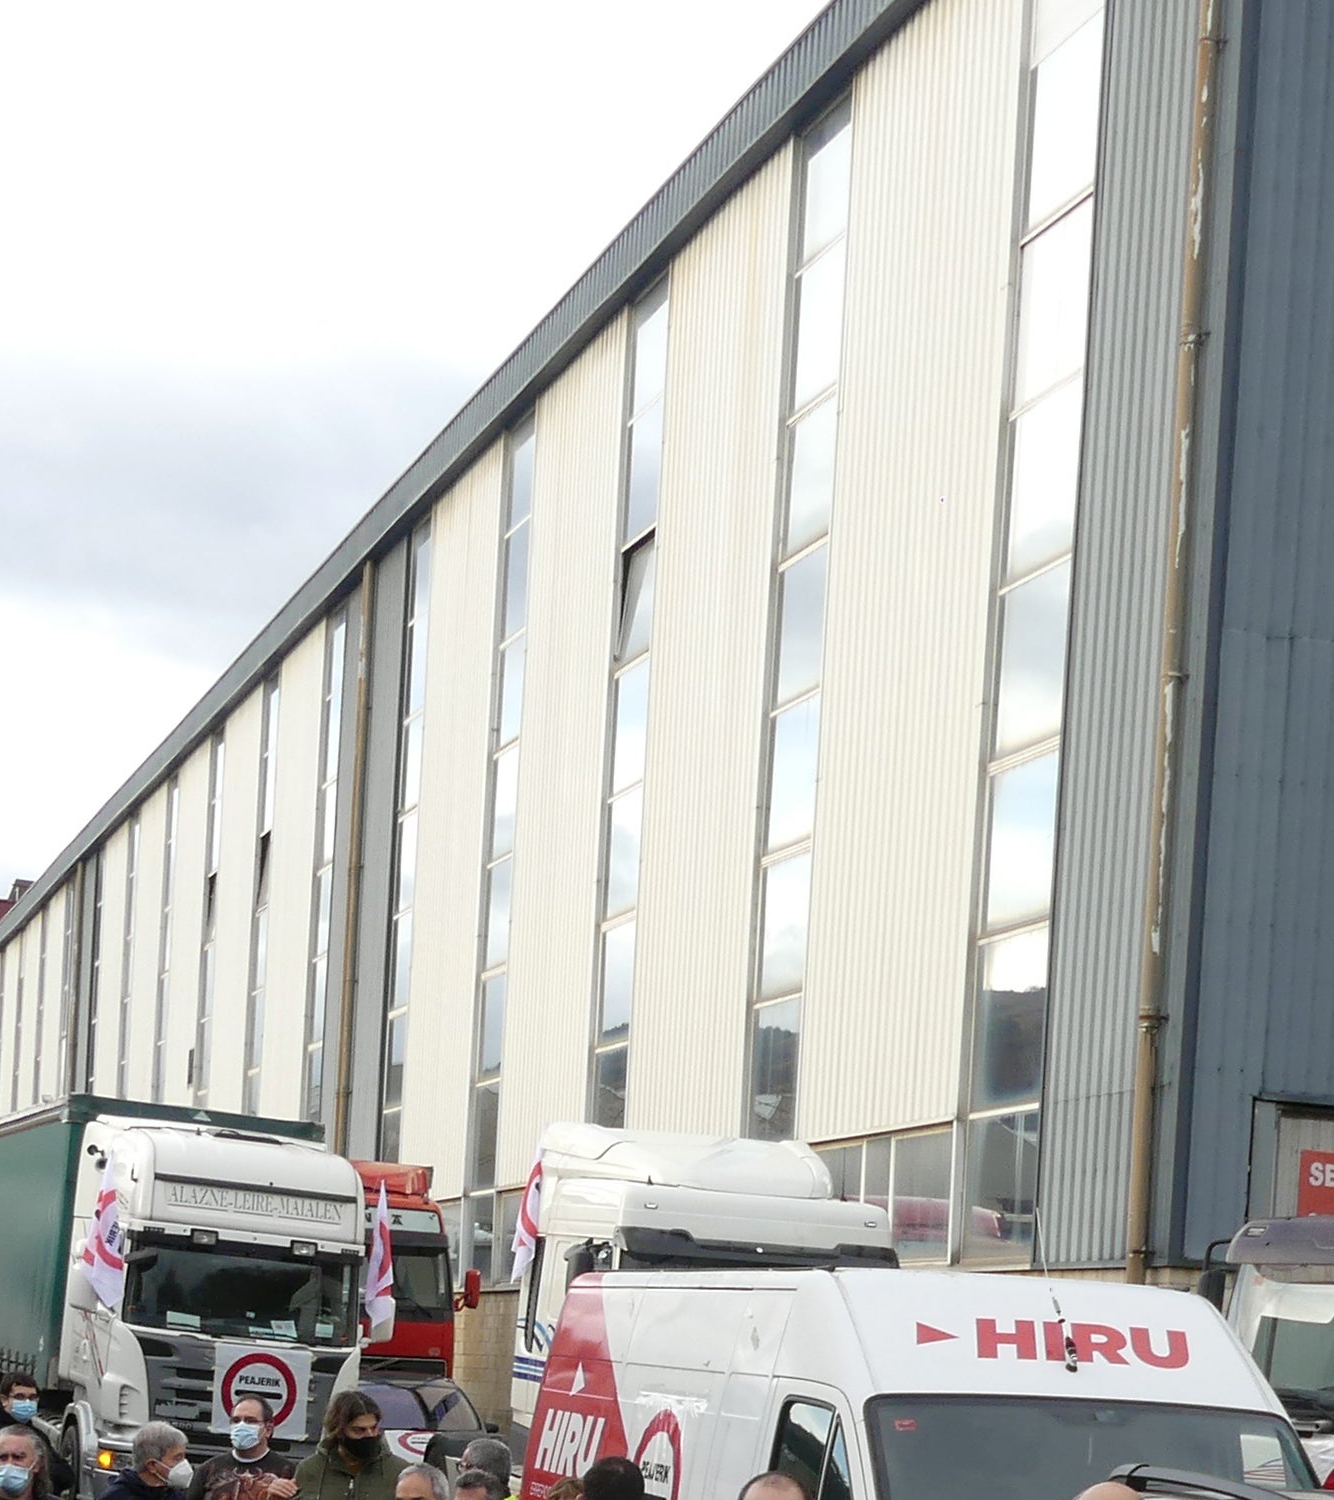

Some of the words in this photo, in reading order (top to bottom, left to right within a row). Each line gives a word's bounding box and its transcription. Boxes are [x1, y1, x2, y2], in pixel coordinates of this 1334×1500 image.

[976, 1318, 1189, 1369] HIRU
[238, 1374, 281, 1388] PEAJERIK
[534, 1408, 606, 1478] HIRU
